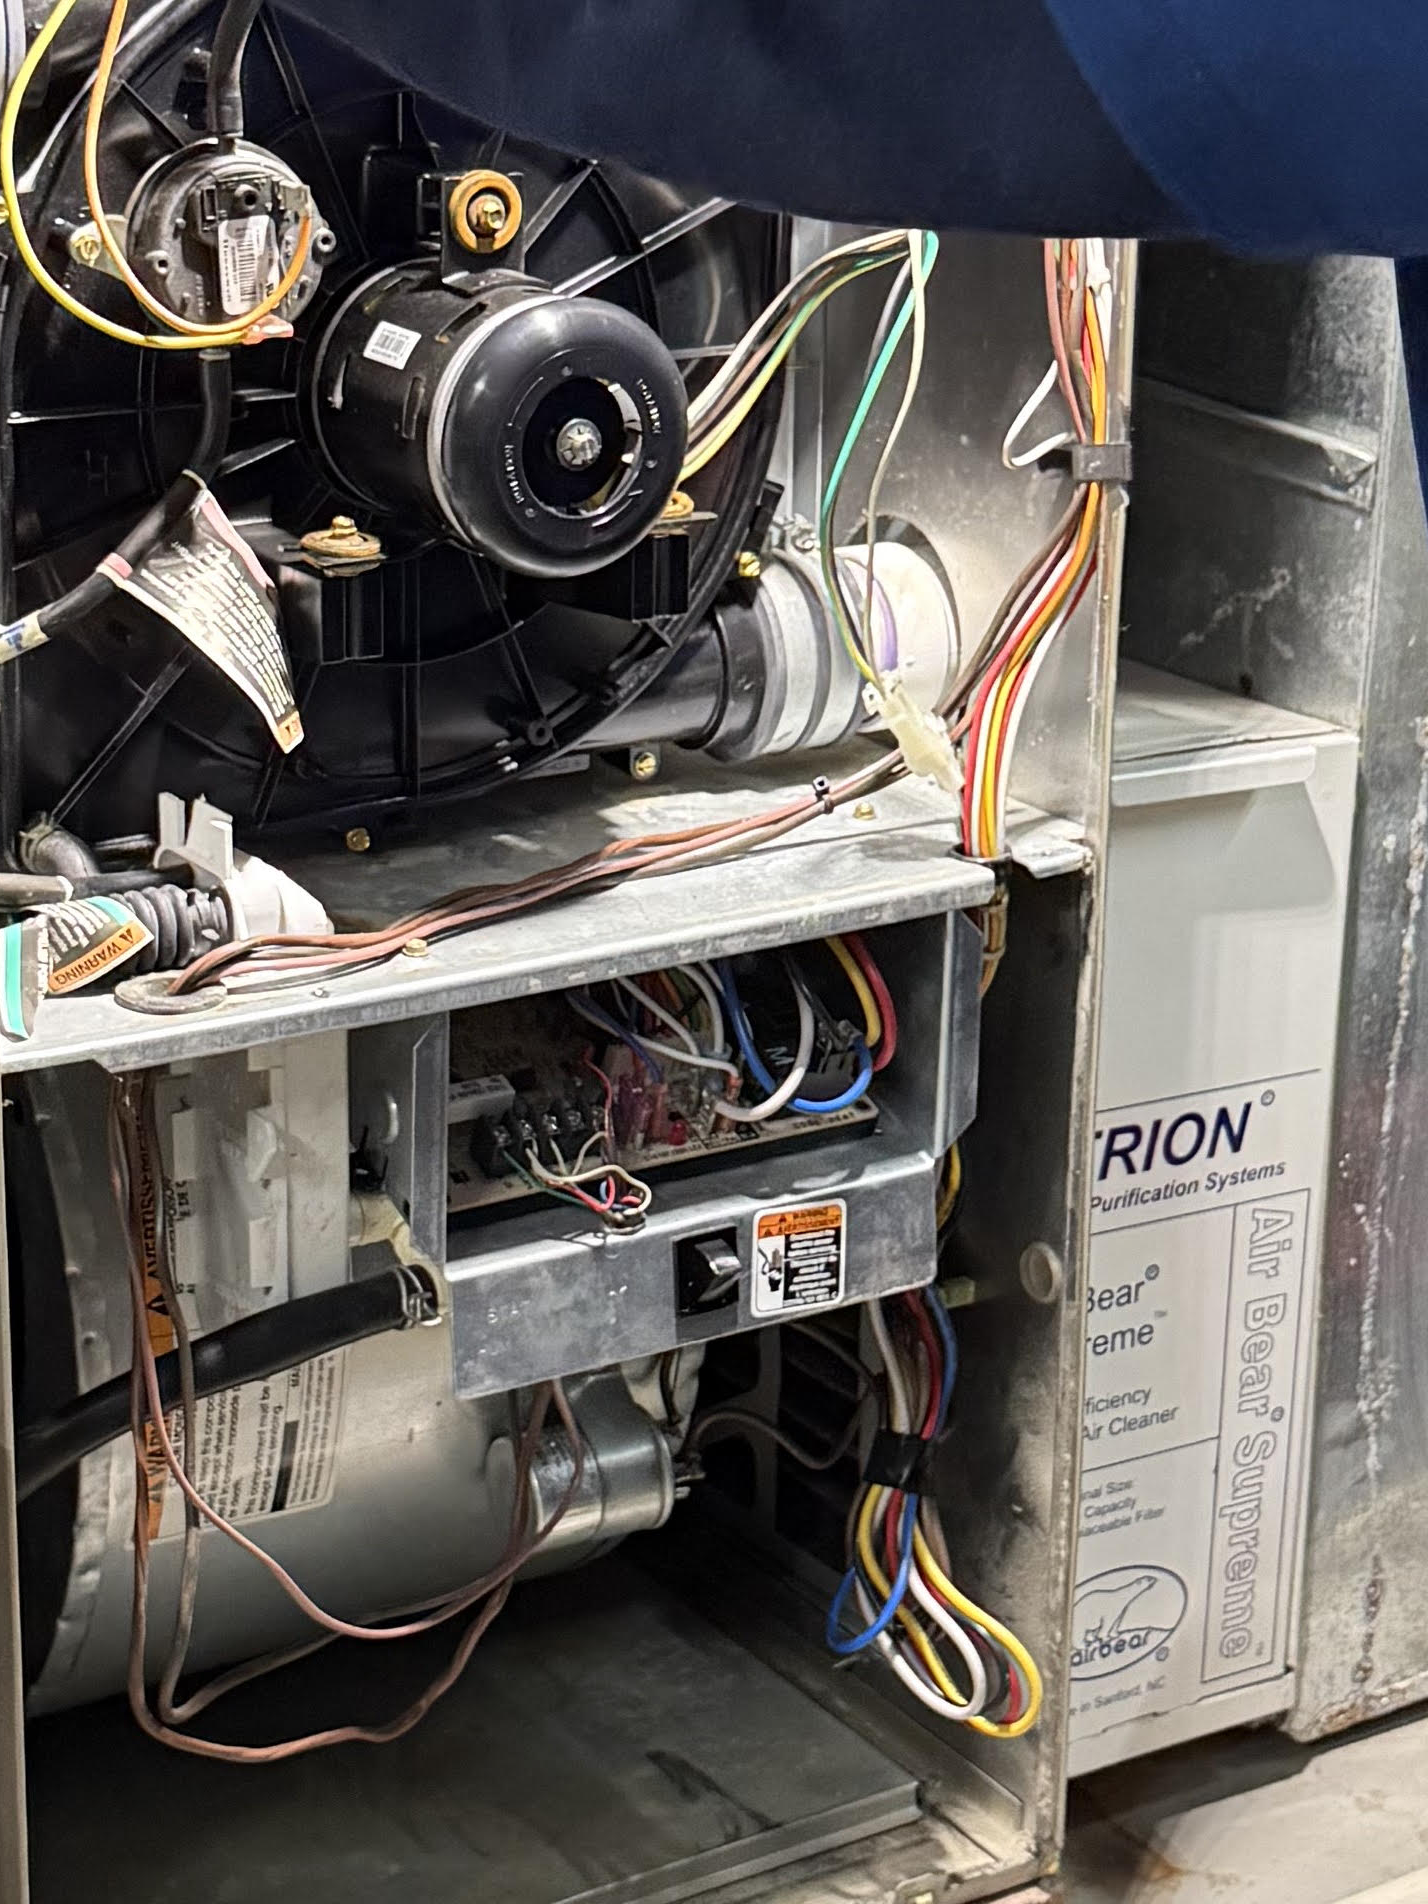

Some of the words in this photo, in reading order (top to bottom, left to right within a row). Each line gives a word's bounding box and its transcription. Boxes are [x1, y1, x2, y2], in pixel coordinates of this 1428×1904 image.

[54, 941, 122, 985] WARNING
[1094, 1101, 1253, 1182] RION
[1090, 1179, 1199, 1213] Purification
[1204, 1161, 1286, 1192] Systems
[1247, 1207, 1294, 1279] Air
[1086, 1322, 1154, 1356] eme
[1236, 1292, 1288, 1418] Bear
[1084, 1387, 1152, 1415] ficiency
[1108, 1406, 1179, 1437] Cleaner
[1218, 1430, 1278, 1659] Supreme
